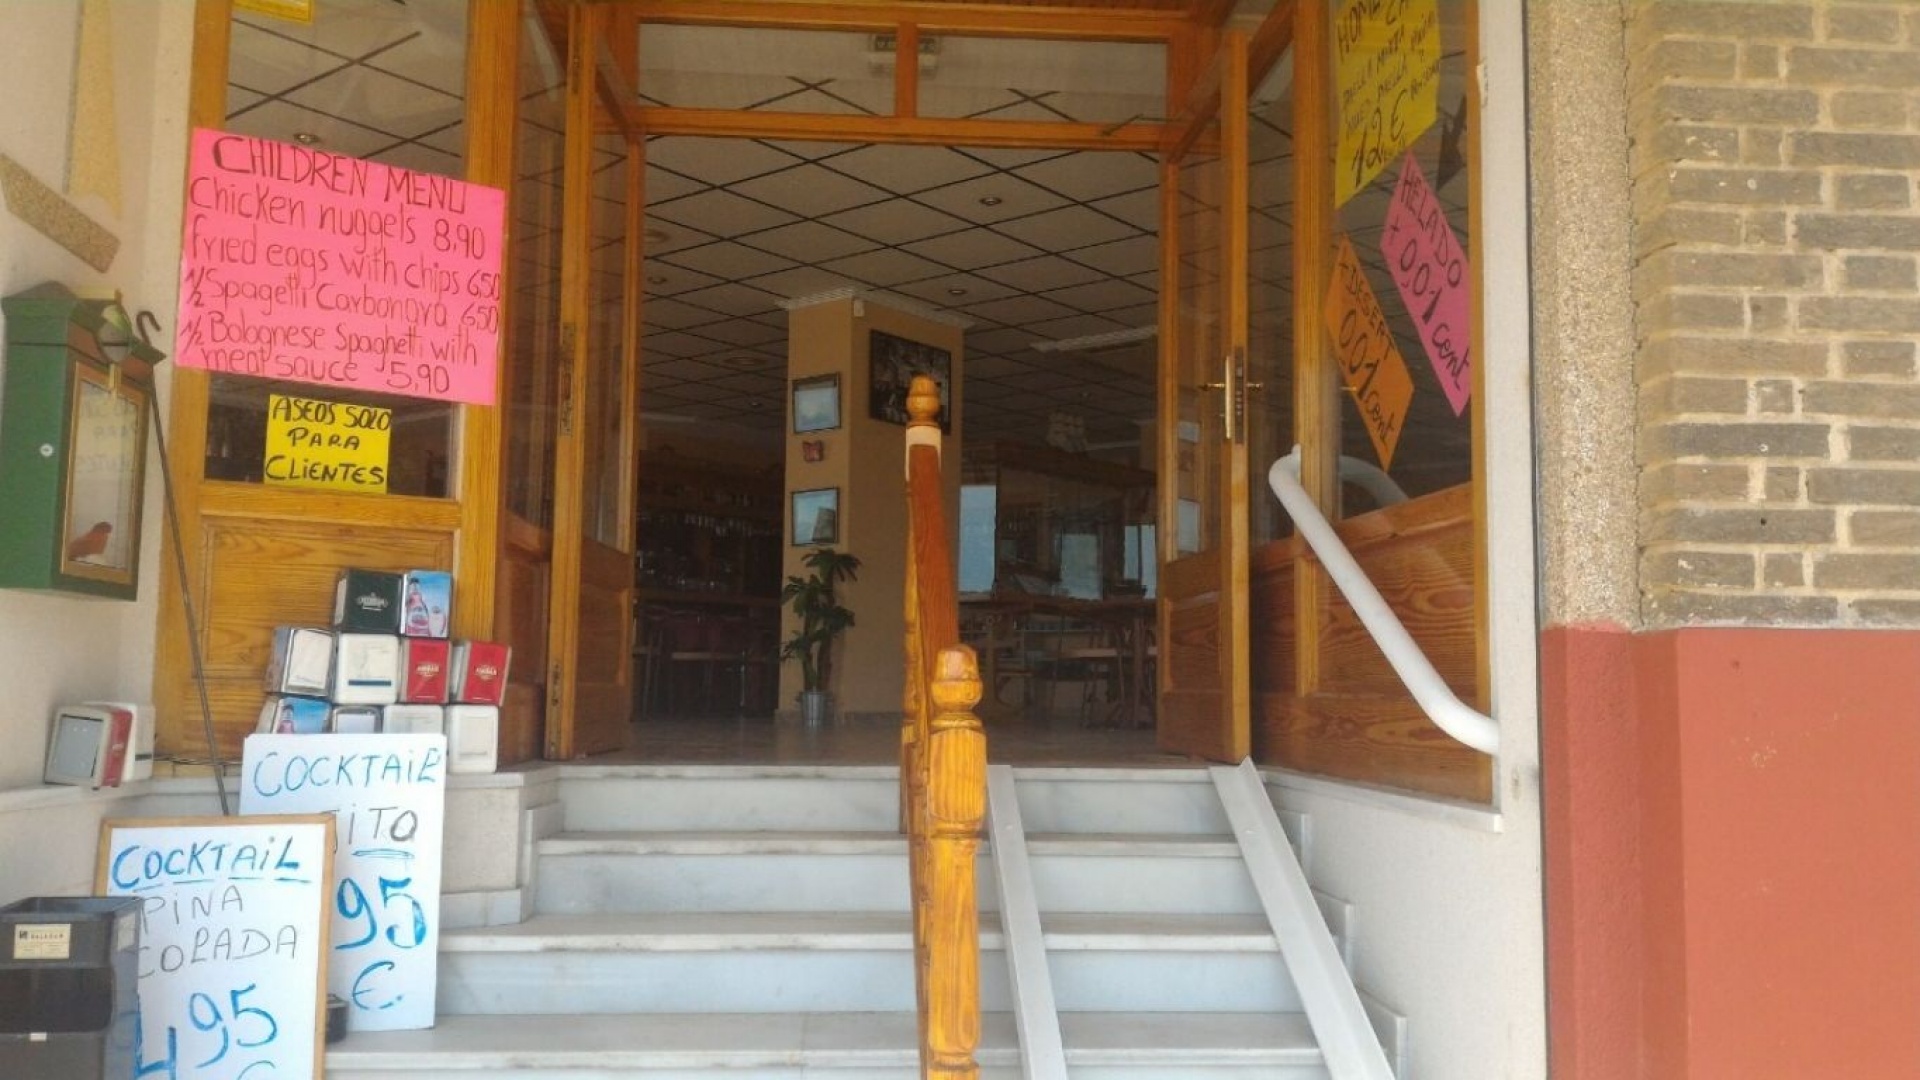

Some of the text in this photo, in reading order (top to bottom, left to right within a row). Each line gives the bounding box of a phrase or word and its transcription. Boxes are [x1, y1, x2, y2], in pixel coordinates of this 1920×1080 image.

[213, 136, 466, 214] CHILDREN MENU
[189, 177, 306, 229] Chicken
[433, 219, 485, 259] 8,90
[1401, 168, 1462, 288] HELADO
[205, 268, 308, 315] Spagetti
[316, 284, 447, 327] Carbonara
[267, 243, 328, 290] eggs
[340, 248, 397, 285] with
[404, 255, 459, 296] chips
[210, 310, 325, 360] Bolognese
[337, 322, 423, 372] Spaghetti
[430, 328, 477, 366] with
[201, 348, 450, 394] meat sauce 5,90
[273, 398, 392, 430] ASEOS SOLO
[287, 427, 360, 450] PARA
